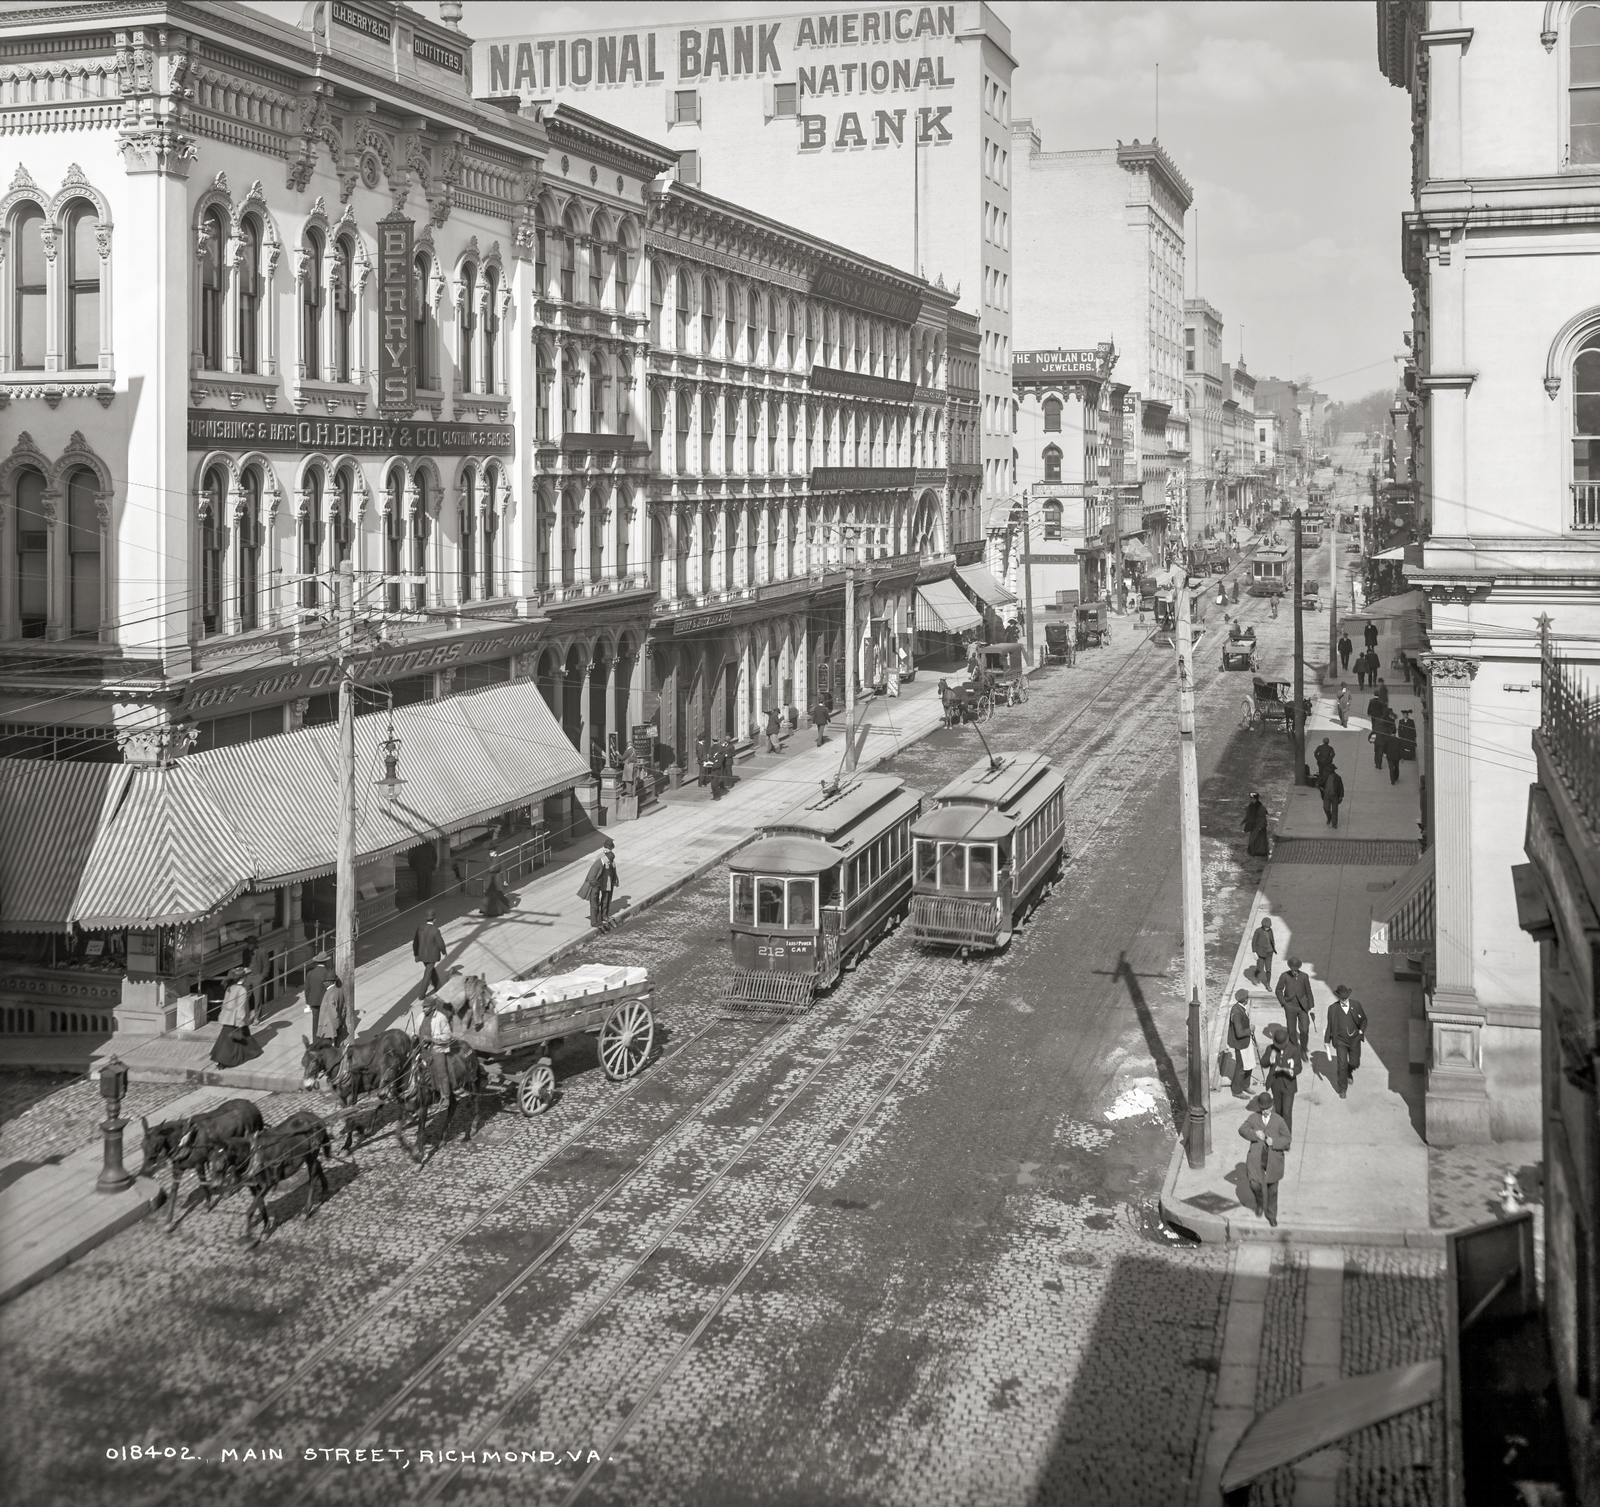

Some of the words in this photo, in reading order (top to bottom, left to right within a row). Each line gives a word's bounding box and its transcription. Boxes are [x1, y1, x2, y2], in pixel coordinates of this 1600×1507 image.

[796, 6, 955, 48] AMERICAN
[489, 32, 665, 95] NATIONAL
[680, 22, 782, 80] BANK
[798, 56, 955, 96] NATIONAL
[799, 106, 953, 153] BANK
[817, 271, 853, 300] OWENS
[862, 286, 890, 312] MINOR
[1036, 352, 1078, 364] NOWLAN
[1080, 352, 1097, 363] CO.
[1041, 363, 1096, 372] JEWELERS.
[814, 370, 869, 392] IMPORTERS
[876, 381, 913, 399] JOBBERS
[258, 422, 267, 440] &
[270, 423, 296, 441] HATS
[400, 427, 413, 448] &
[442, 431, 478, 447] CLOTHING
[486, 432, 511, 448] SHOES
[186, 672, 303, 711] 1017-1019
[758, 946, 784, 957] 212
